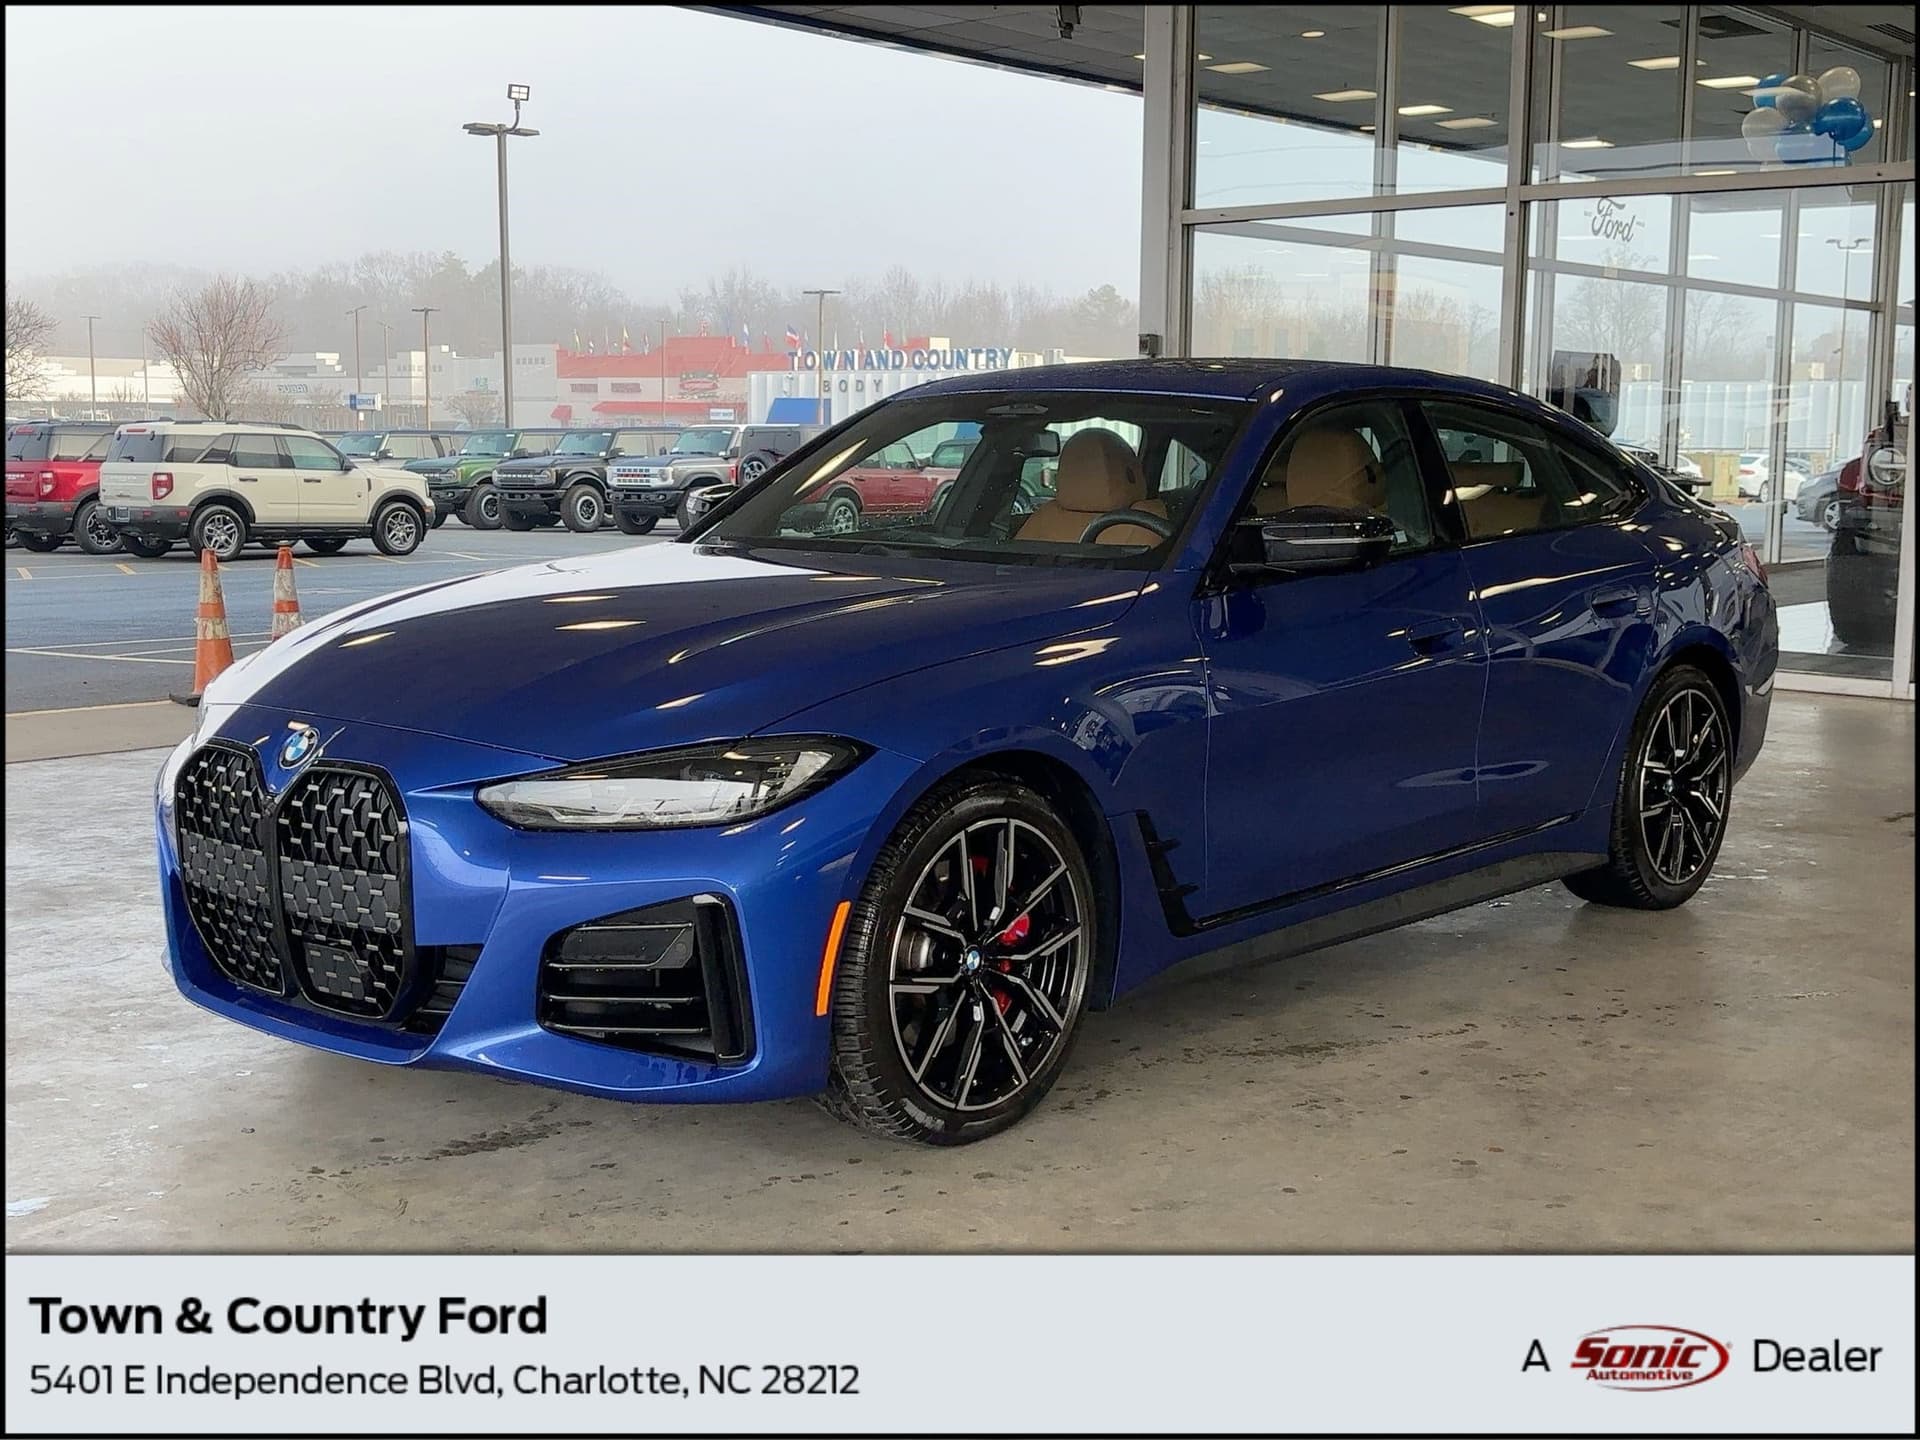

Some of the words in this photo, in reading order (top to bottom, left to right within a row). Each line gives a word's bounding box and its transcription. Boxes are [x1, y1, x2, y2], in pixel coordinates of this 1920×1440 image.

[1592, 197, 1635, 242] Ford
[787, 350, 857, 370] TOWN
[864, 349, 904, 370] AND
[912, 348, 1016, 370] COUNTRY
[823, 379, 882, 393] BODY
